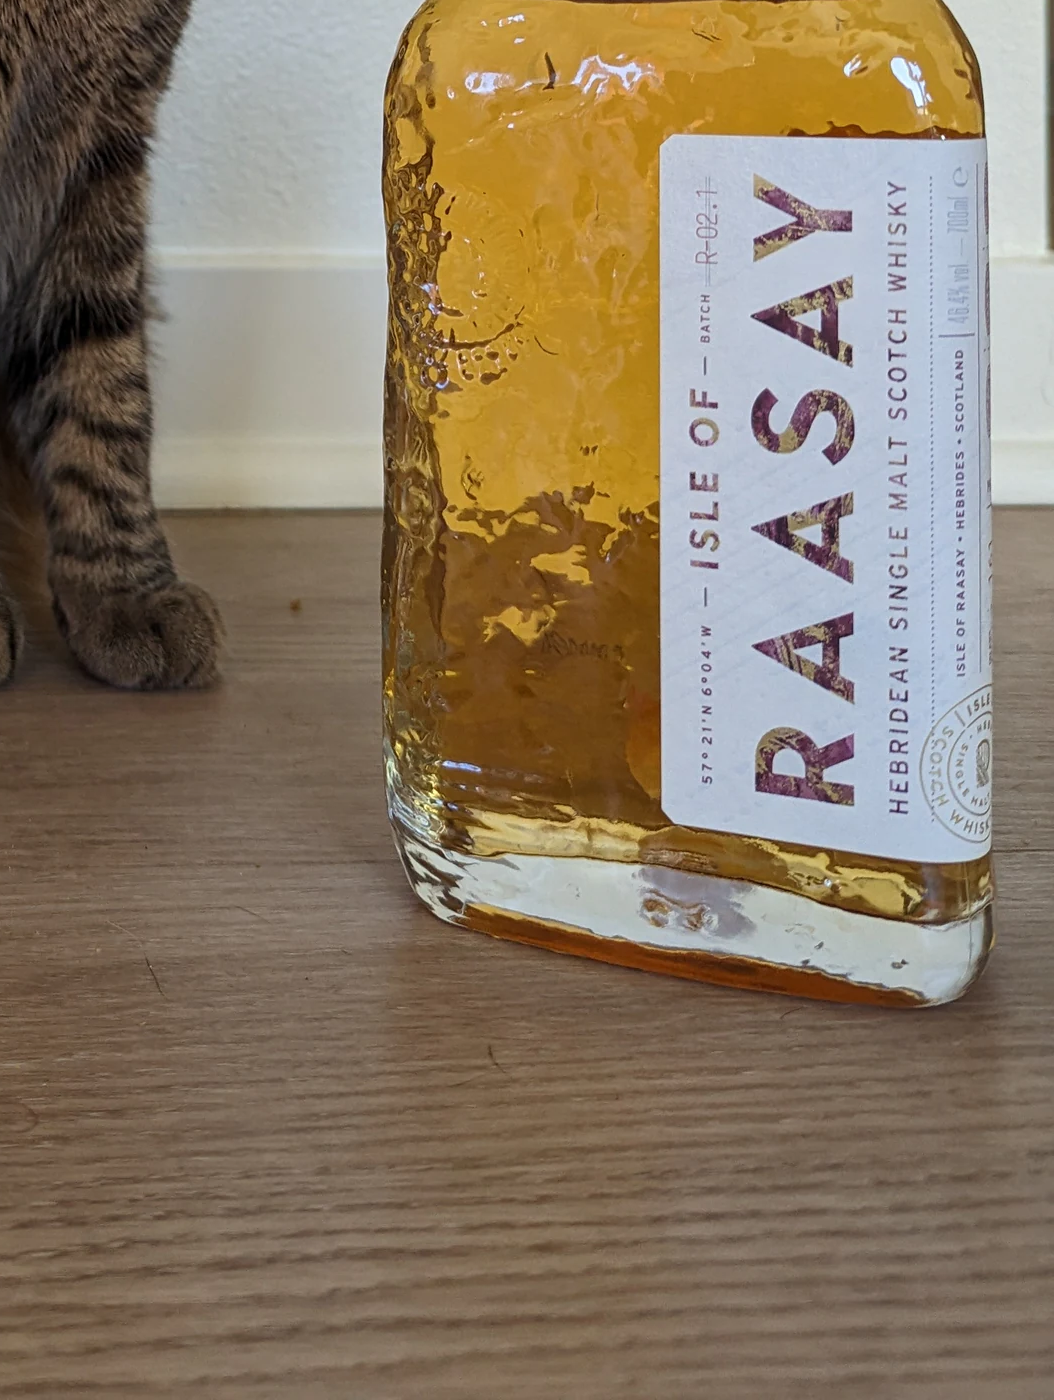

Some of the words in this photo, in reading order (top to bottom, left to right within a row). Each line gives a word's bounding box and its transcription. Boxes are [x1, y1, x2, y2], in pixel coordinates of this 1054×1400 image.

[694, 187, 719, 266] R-02.1
[887, 181, 908, 292] WHISKY
[699, 294, 711, 344] BATCH
[887, 308, 908, 421] SCOTCH
[954, 350, 965, 433] SCOTLAND
[688, 388, 720, 448] OF
[750, 174, 856, 807] RAASAY
[887, 435, 908, 511] MALT
[955, 451, 965, 530] HEBRIDES
[689, 471, 720, 571] ISLE
[888, 526, 909, 631] SINGLE
[955, 548, 966, 612] RAASAY
[955, 618, 966, 638] OF
[955, 642, 966, 678] ISLE
[700, 705, 713, 746] 21'N
[888, 646, 909, 815] HEBRIDEAN
[928, 725, 954, 807] SCOTCH
